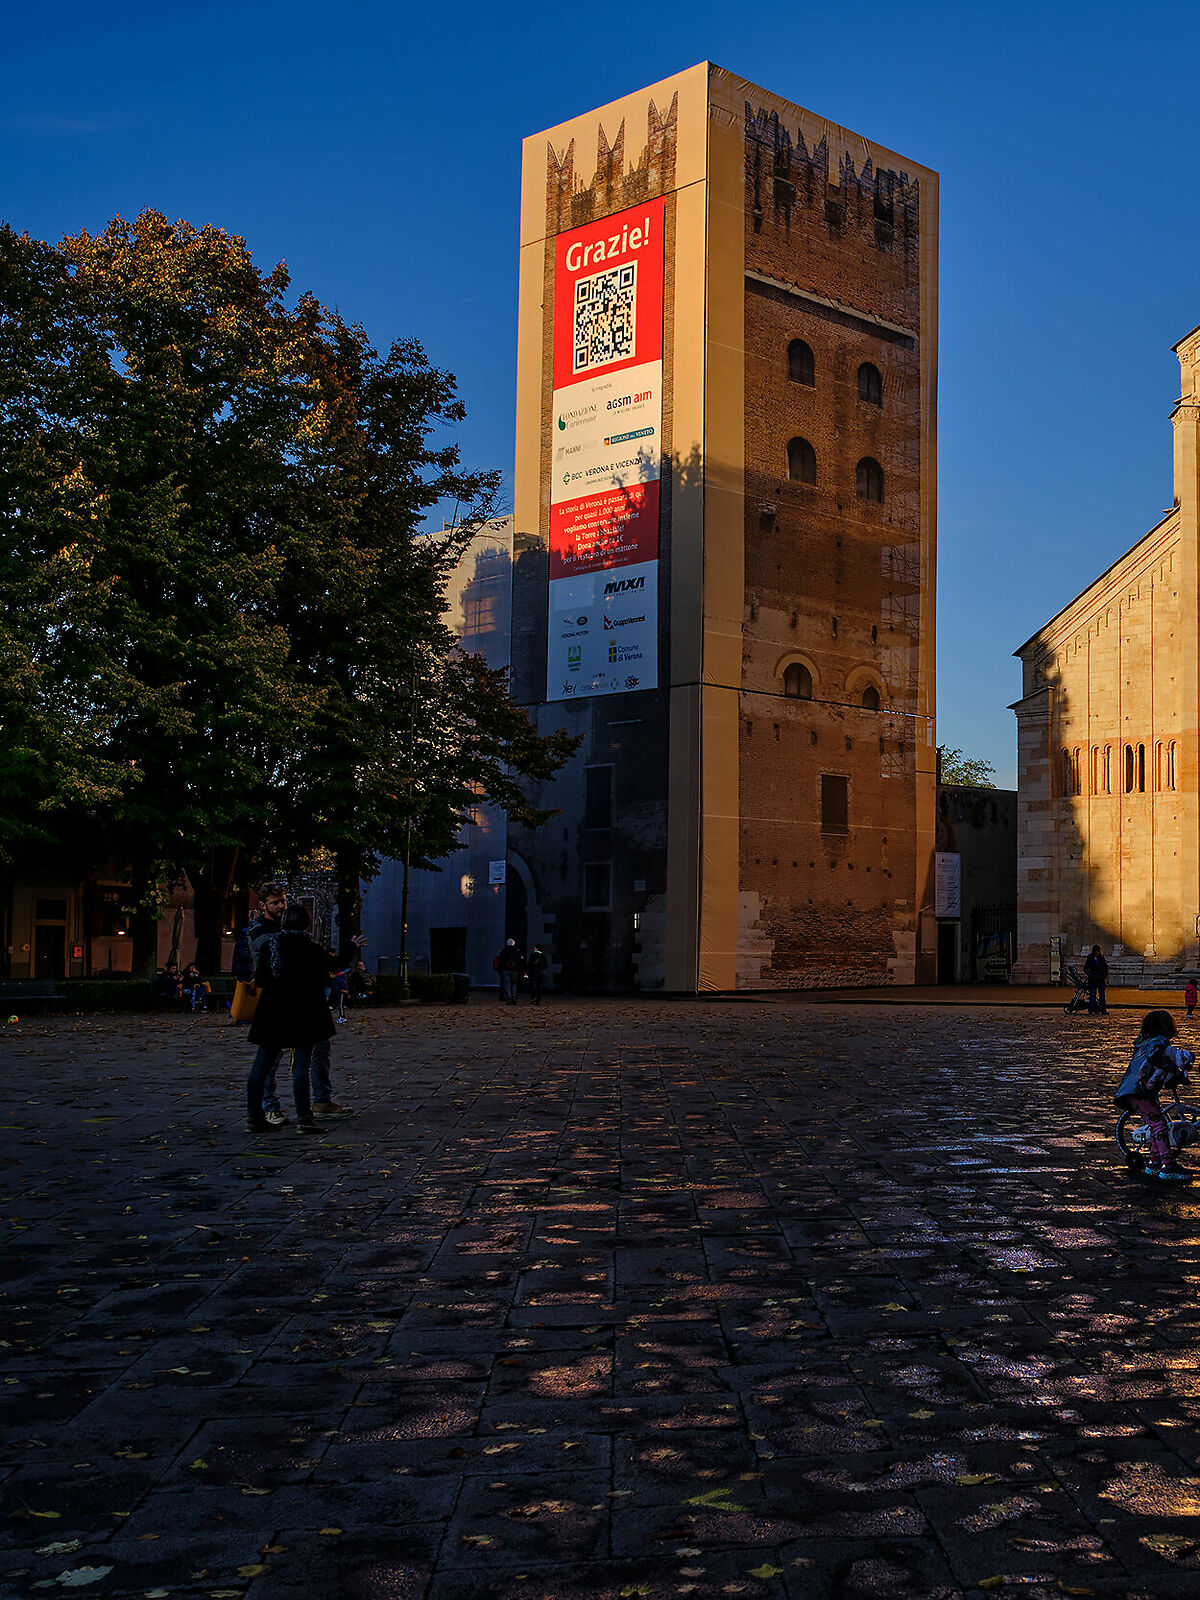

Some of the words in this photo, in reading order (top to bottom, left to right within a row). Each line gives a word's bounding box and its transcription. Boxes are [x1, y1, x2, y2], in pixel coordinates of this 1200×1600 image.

[565, 217, 650, 272] Grazie!
[585, 465, 609, 476] VERONA
[610, 463, 614, 471] E
[616, 457, 643, 469] VICENZA
[585, 499, 603, 509] Verona
[574, 513, 584, 522] per
[563, 523, 587, 535] vogliamo
